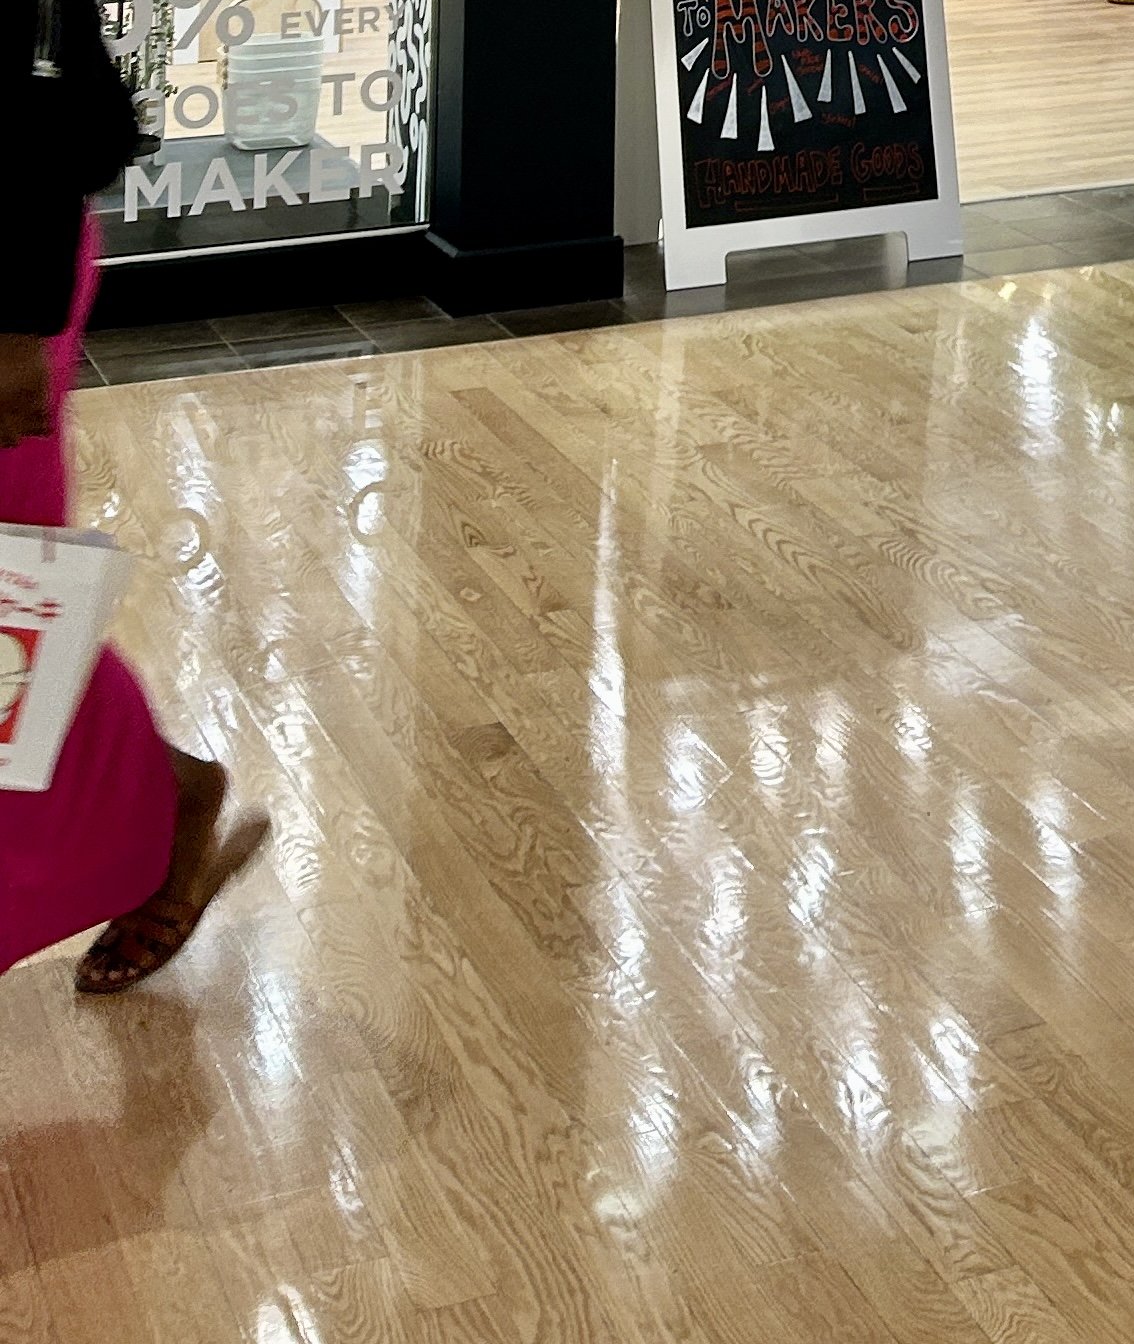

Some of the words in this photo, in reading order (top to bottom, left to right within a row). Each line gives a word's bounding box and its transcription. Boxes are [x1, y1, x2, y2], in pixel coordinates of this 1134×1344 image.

[281, 4, 408, 39] EVERY
[321, 69, 404, 116] TO
[123, 141, 407, 224] MAKER
[693, 145, 844, 209] HANDMADE
[850, 142, 925, 183] GOODS
